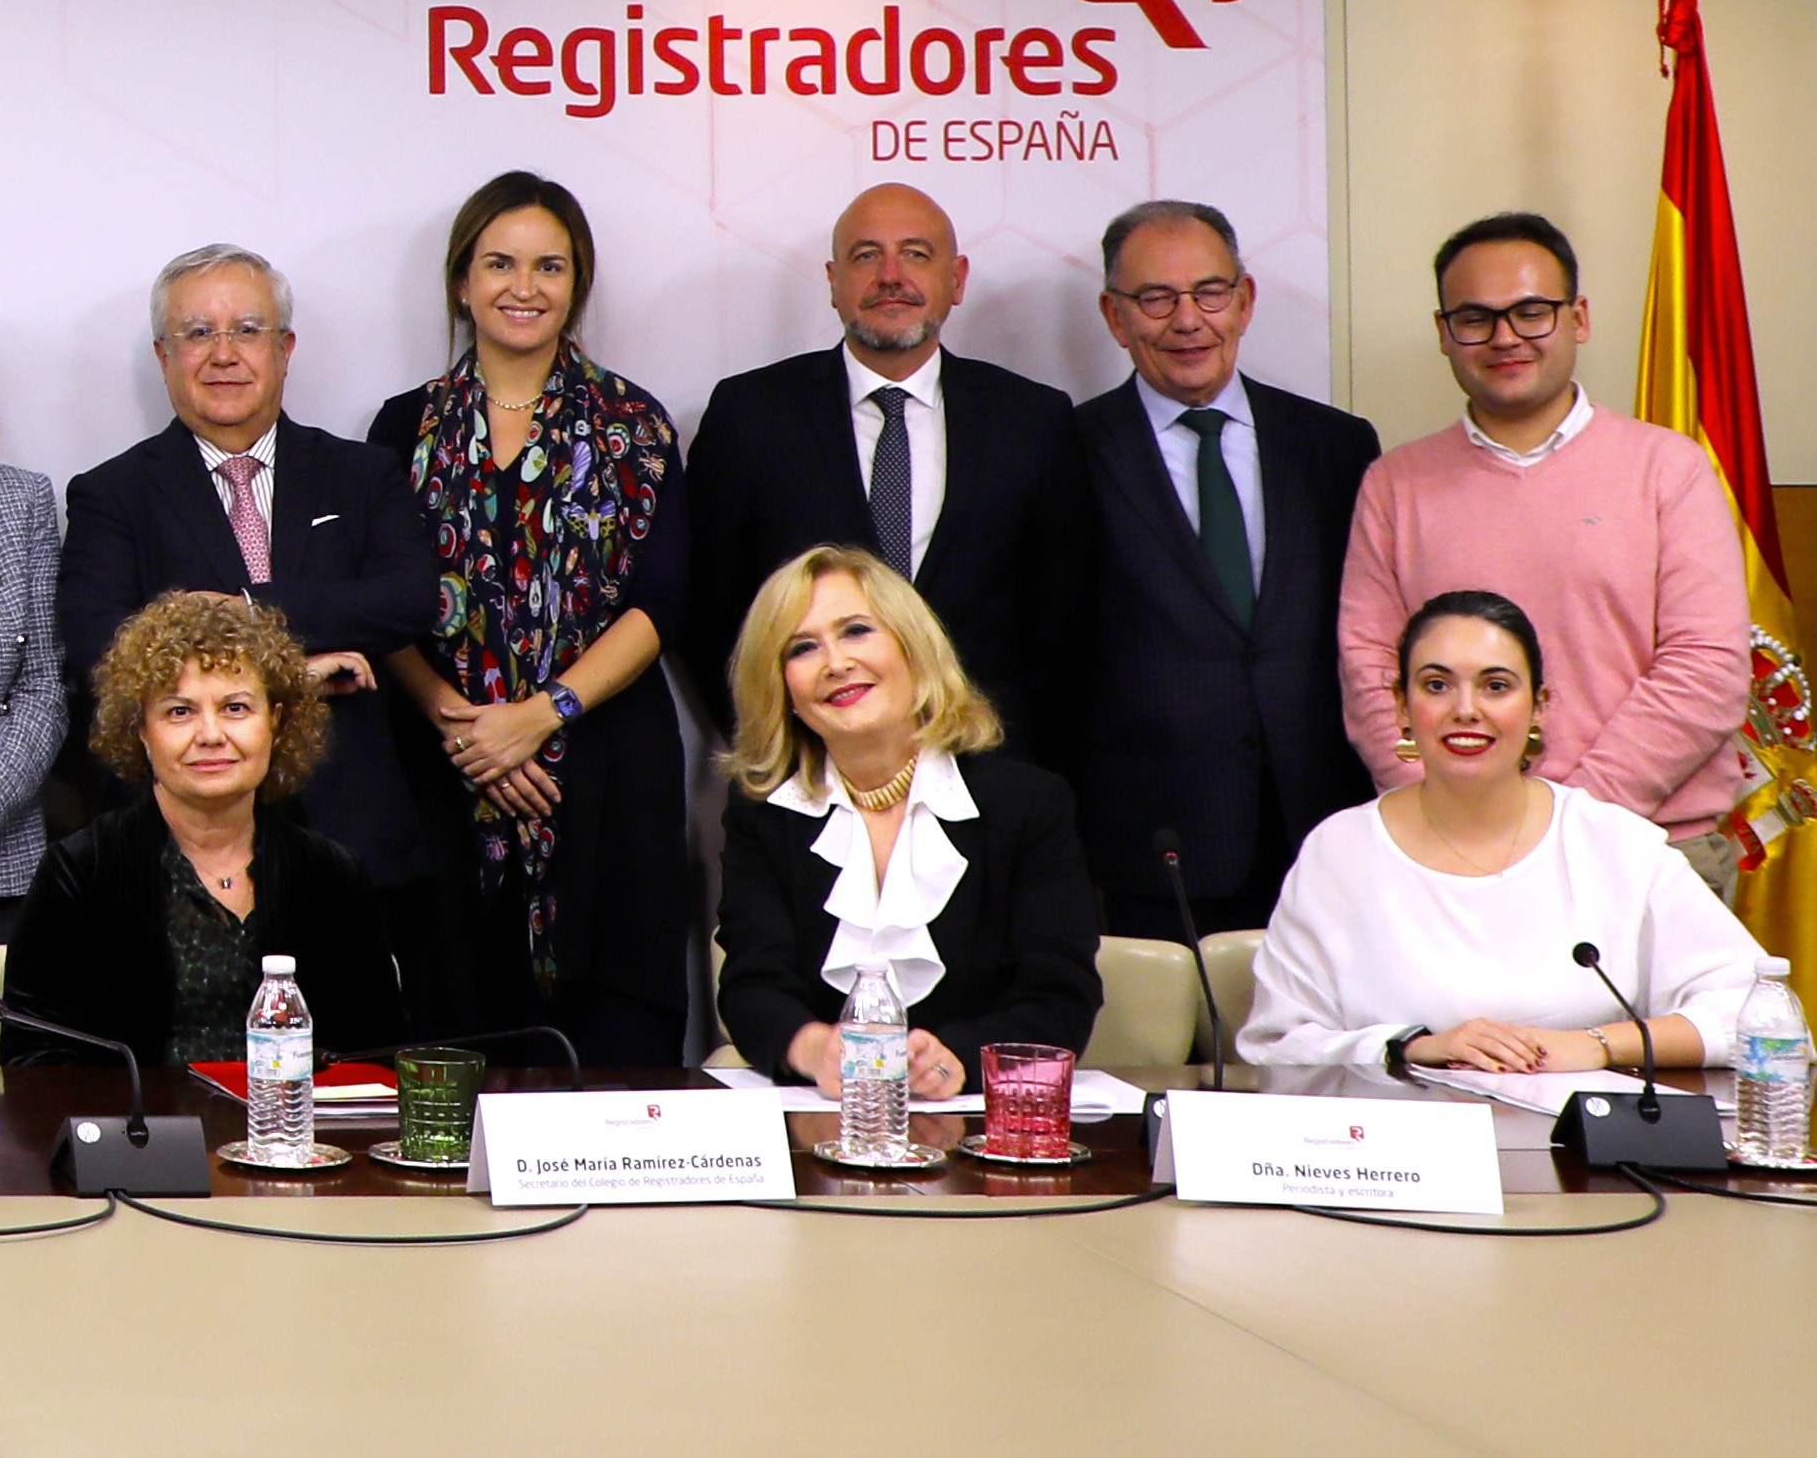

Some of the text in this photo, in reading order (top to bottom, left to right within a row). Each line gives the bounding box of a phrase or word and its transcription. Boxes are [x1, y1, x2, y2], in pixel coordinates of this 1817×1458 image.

[428, 4, 1118, 119] Registradores
[872, 110, 1119, 162] DE ESPAÑA
[516, 1153, 763, 1175] D. José María Ramírez-Cárdenas
[1252, 1162, 1421, 1184] Dña. Nieves Herrero
[518, 1173, 765, 1190] Secretario del Colegio de Registradores de España
[1282, 1183, 1335, 1196] Periodista
[1348, 1188, 1394, 1198] escritora
